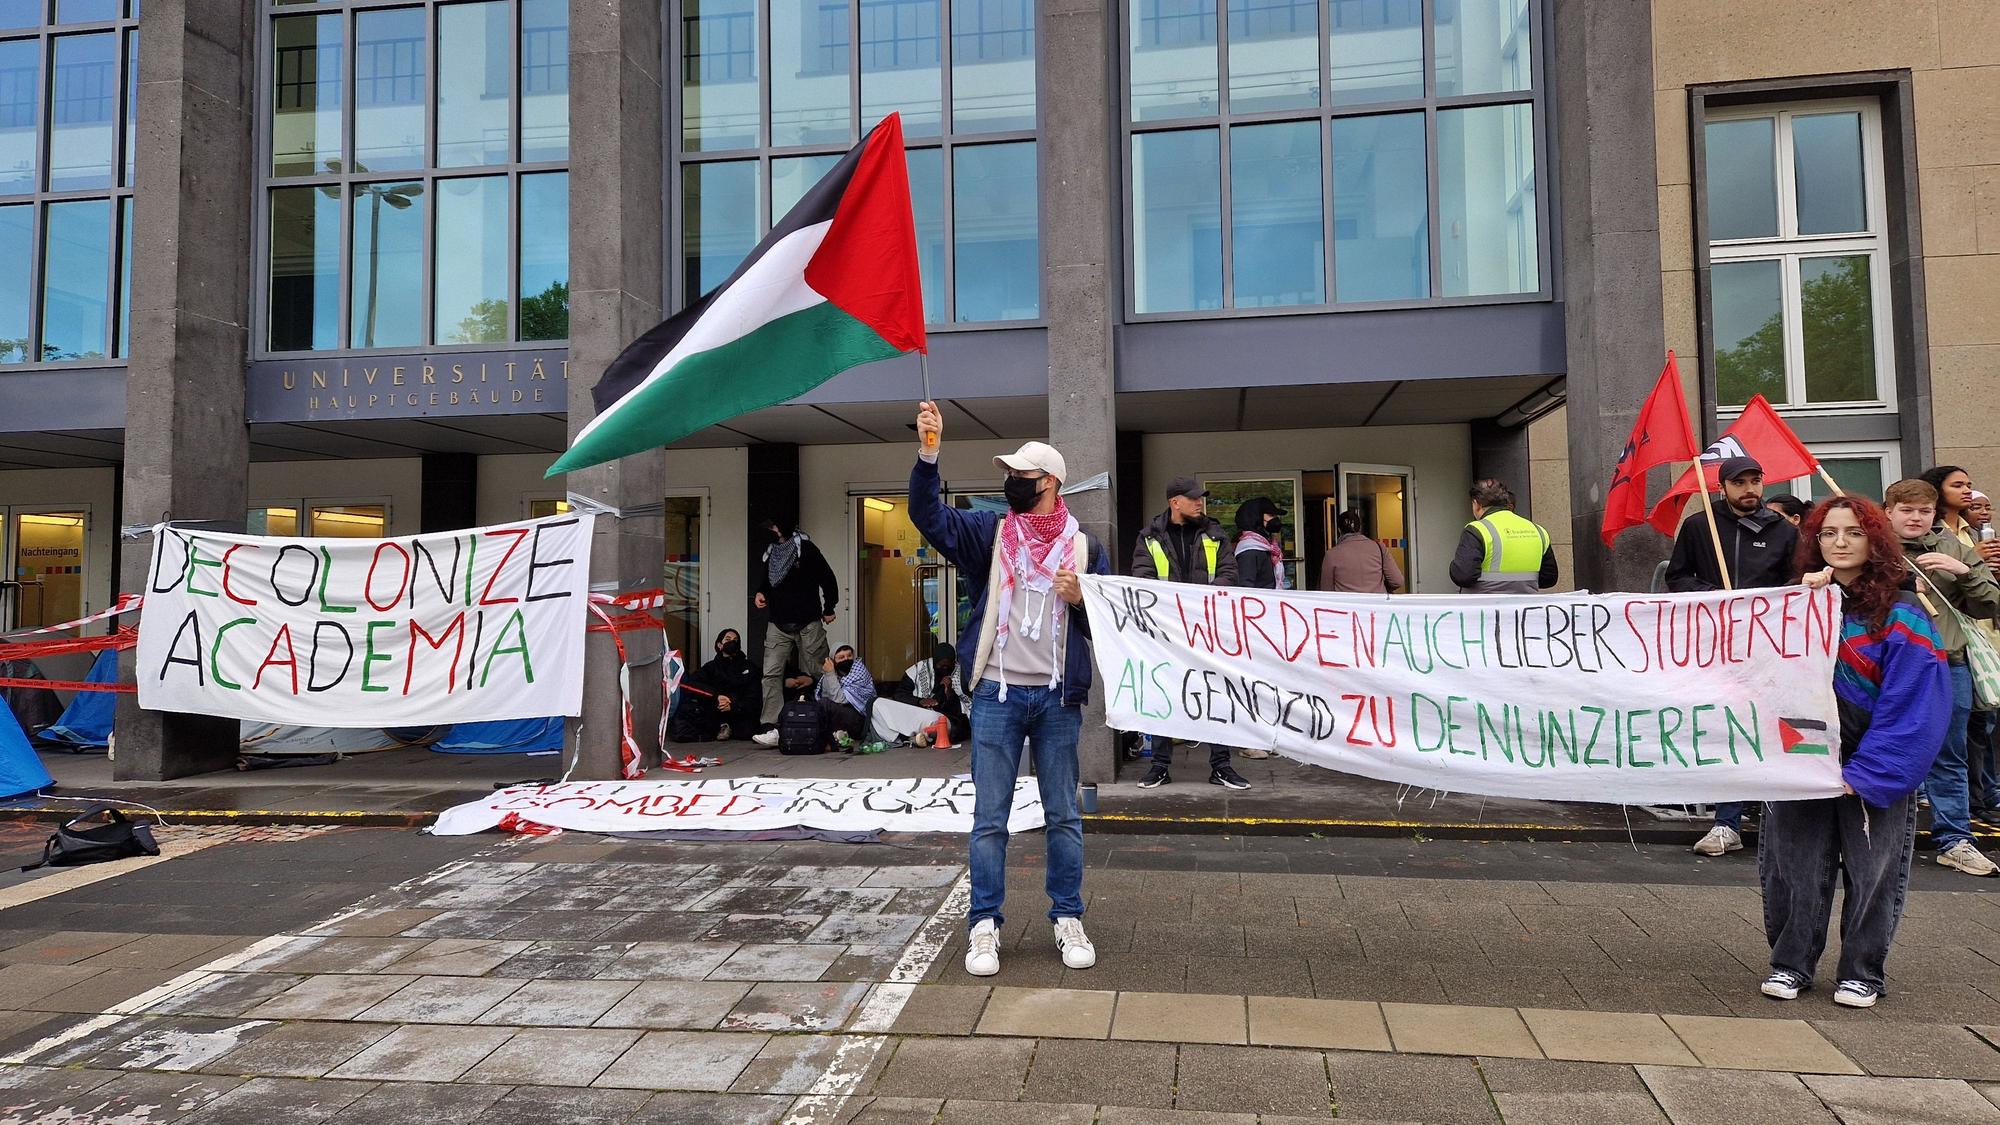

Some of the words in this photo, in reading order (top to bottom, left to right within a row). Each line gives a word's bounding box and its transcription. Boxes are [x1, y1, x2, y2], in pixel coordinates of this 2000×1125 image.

[310, 388, 543, 409] HAUPTGEBÄUDE
[21, 546, 79, 558] Nachteingang
[153, 518, 579, 612] DECOLONIZE
[159, 607, 535, 696] ACADEMIA
[1176, 591, 1376, 669] WÜRDEN
[1382, 609, 1488, 674] AUCH
[1494, 603, 1626, 673] LIEBER
[1624, 588, 1833, 673] STUDIEREN
[1112, 657, 1172, 720] ALS
[1181, 668, 1335, 741] GENOZID
[1341, 694, 1395, 748] ZU
[1411, 692, 1765, 769] DENUNZIEREN
